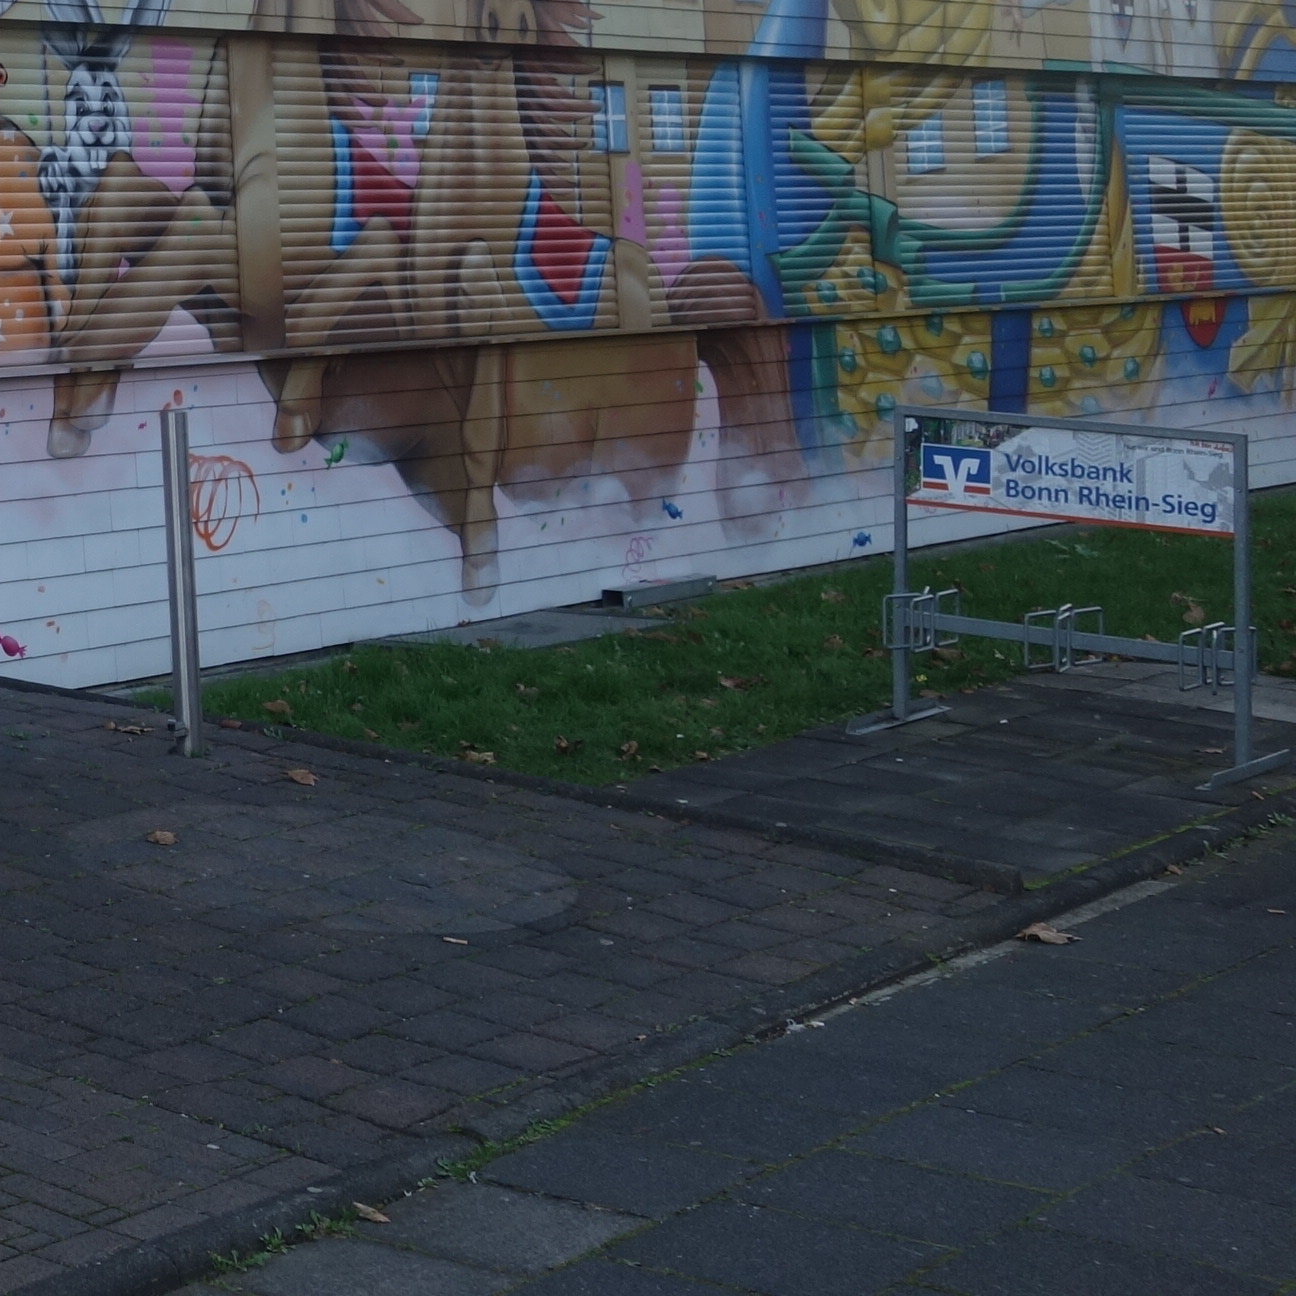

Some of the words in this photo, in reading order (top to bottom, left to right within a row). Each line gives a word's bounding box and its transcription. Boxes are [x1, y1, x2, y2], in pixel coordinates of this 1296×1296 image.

[1004, 452, 1134, 485] Volksbank
[1005, 478, 1069, 504] Bonn
[1078, 485, 1218, 524] Rhein-Sieg
